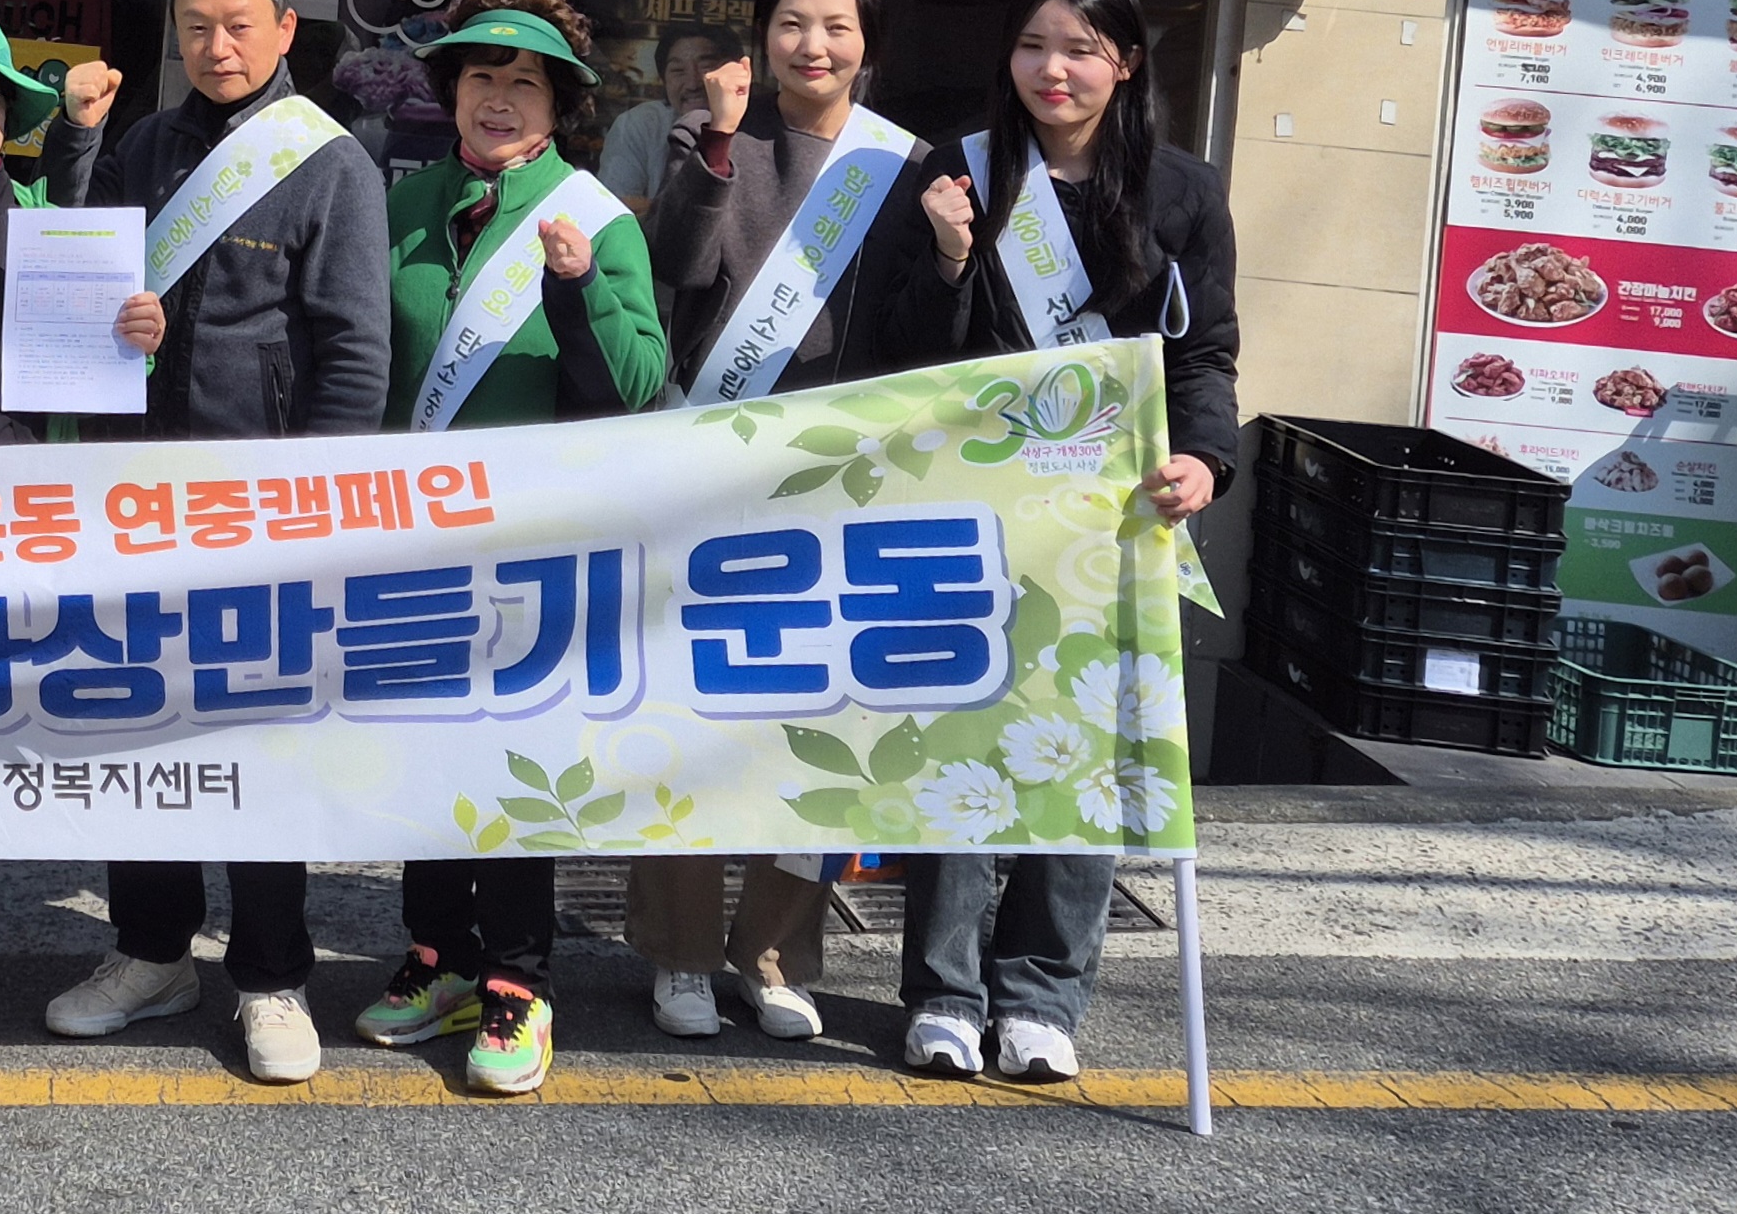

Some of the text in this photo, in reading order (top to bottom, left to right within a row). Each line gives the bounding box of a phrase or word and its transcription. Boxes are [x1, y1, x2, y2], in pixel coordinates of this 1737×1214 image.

[717, 282, 802, 403] 탄소중립
[960, 362, 1098, 466] 30
[1076, 458, 1098, 473] 사상
[103, 459, 496, 556] 연중캠페인
[679, 515, 996, 695] 운동
